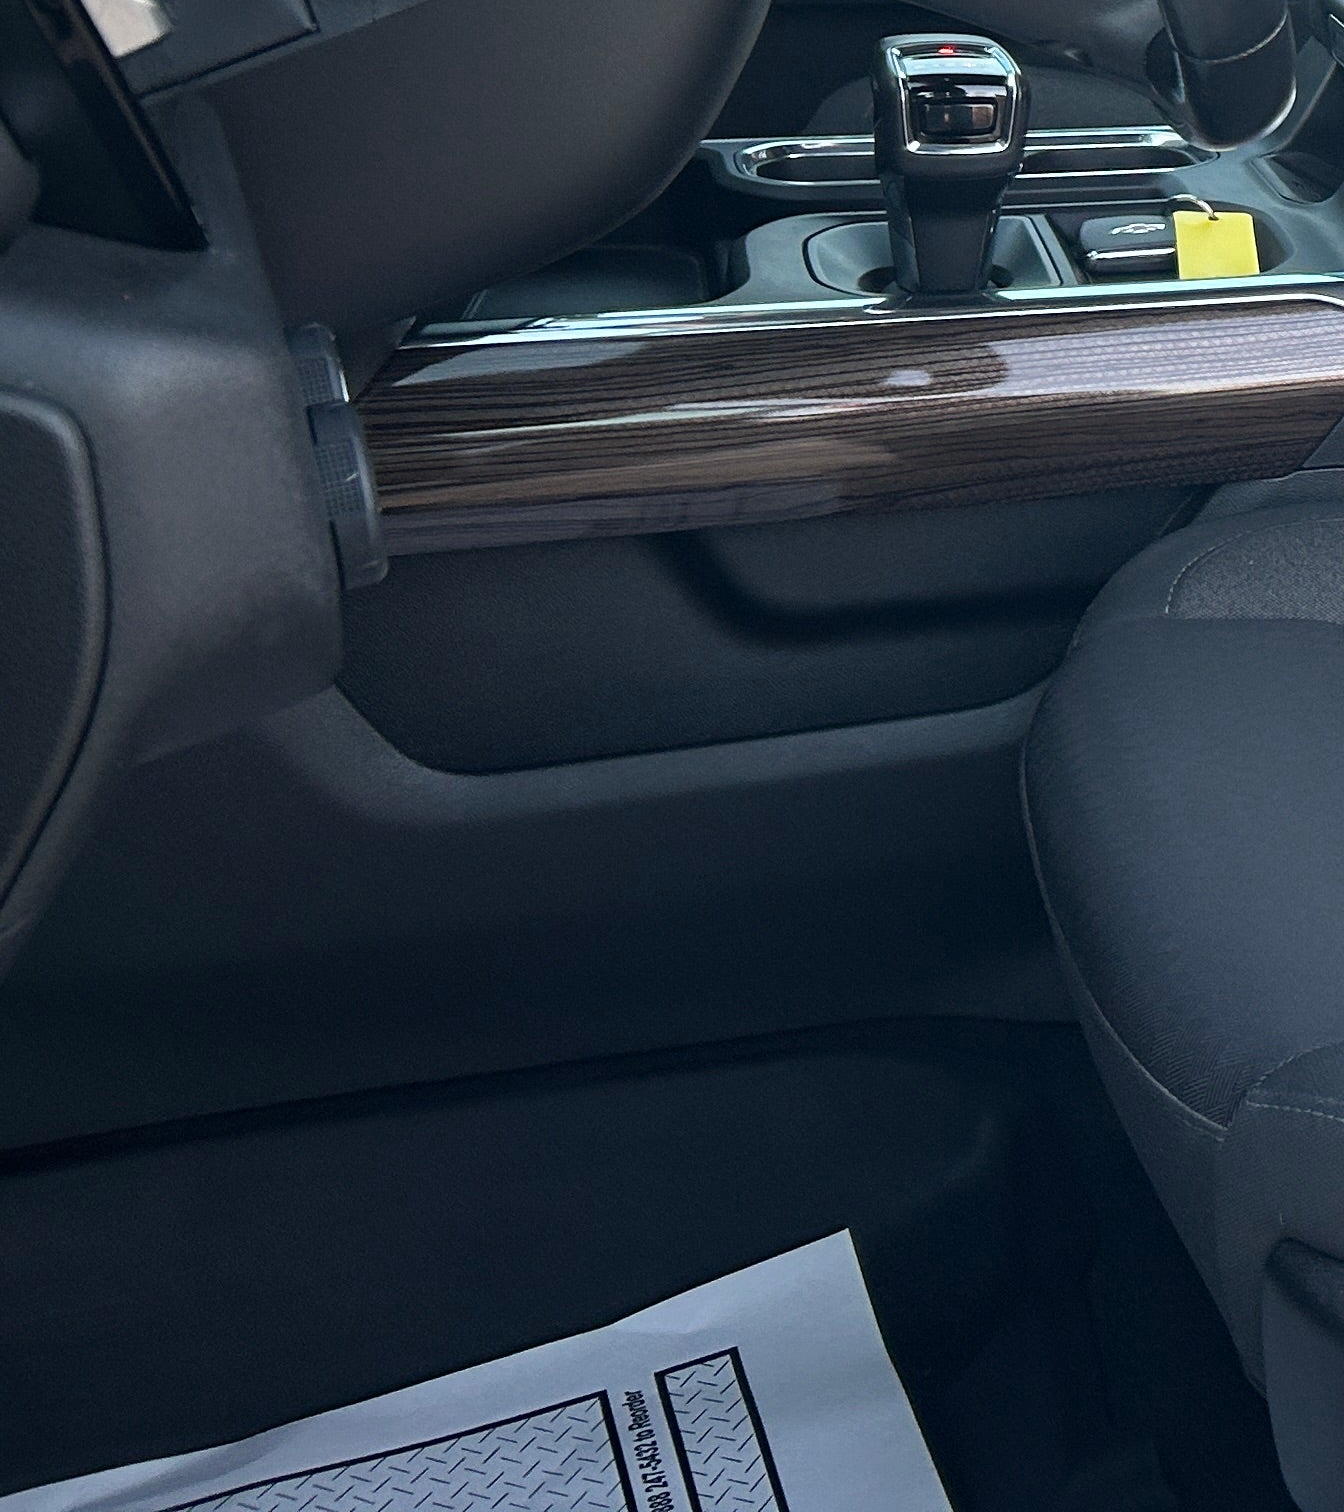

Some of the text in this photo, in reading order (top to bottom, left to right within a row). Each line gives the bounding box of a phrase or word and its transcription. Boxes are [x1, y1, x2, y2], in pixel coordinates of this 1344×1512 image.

[622, 1390, 651, 1431] Reorder
[633, 1429, 656, 1442] to
[634, 1440, 668, 1492] 247-5432
